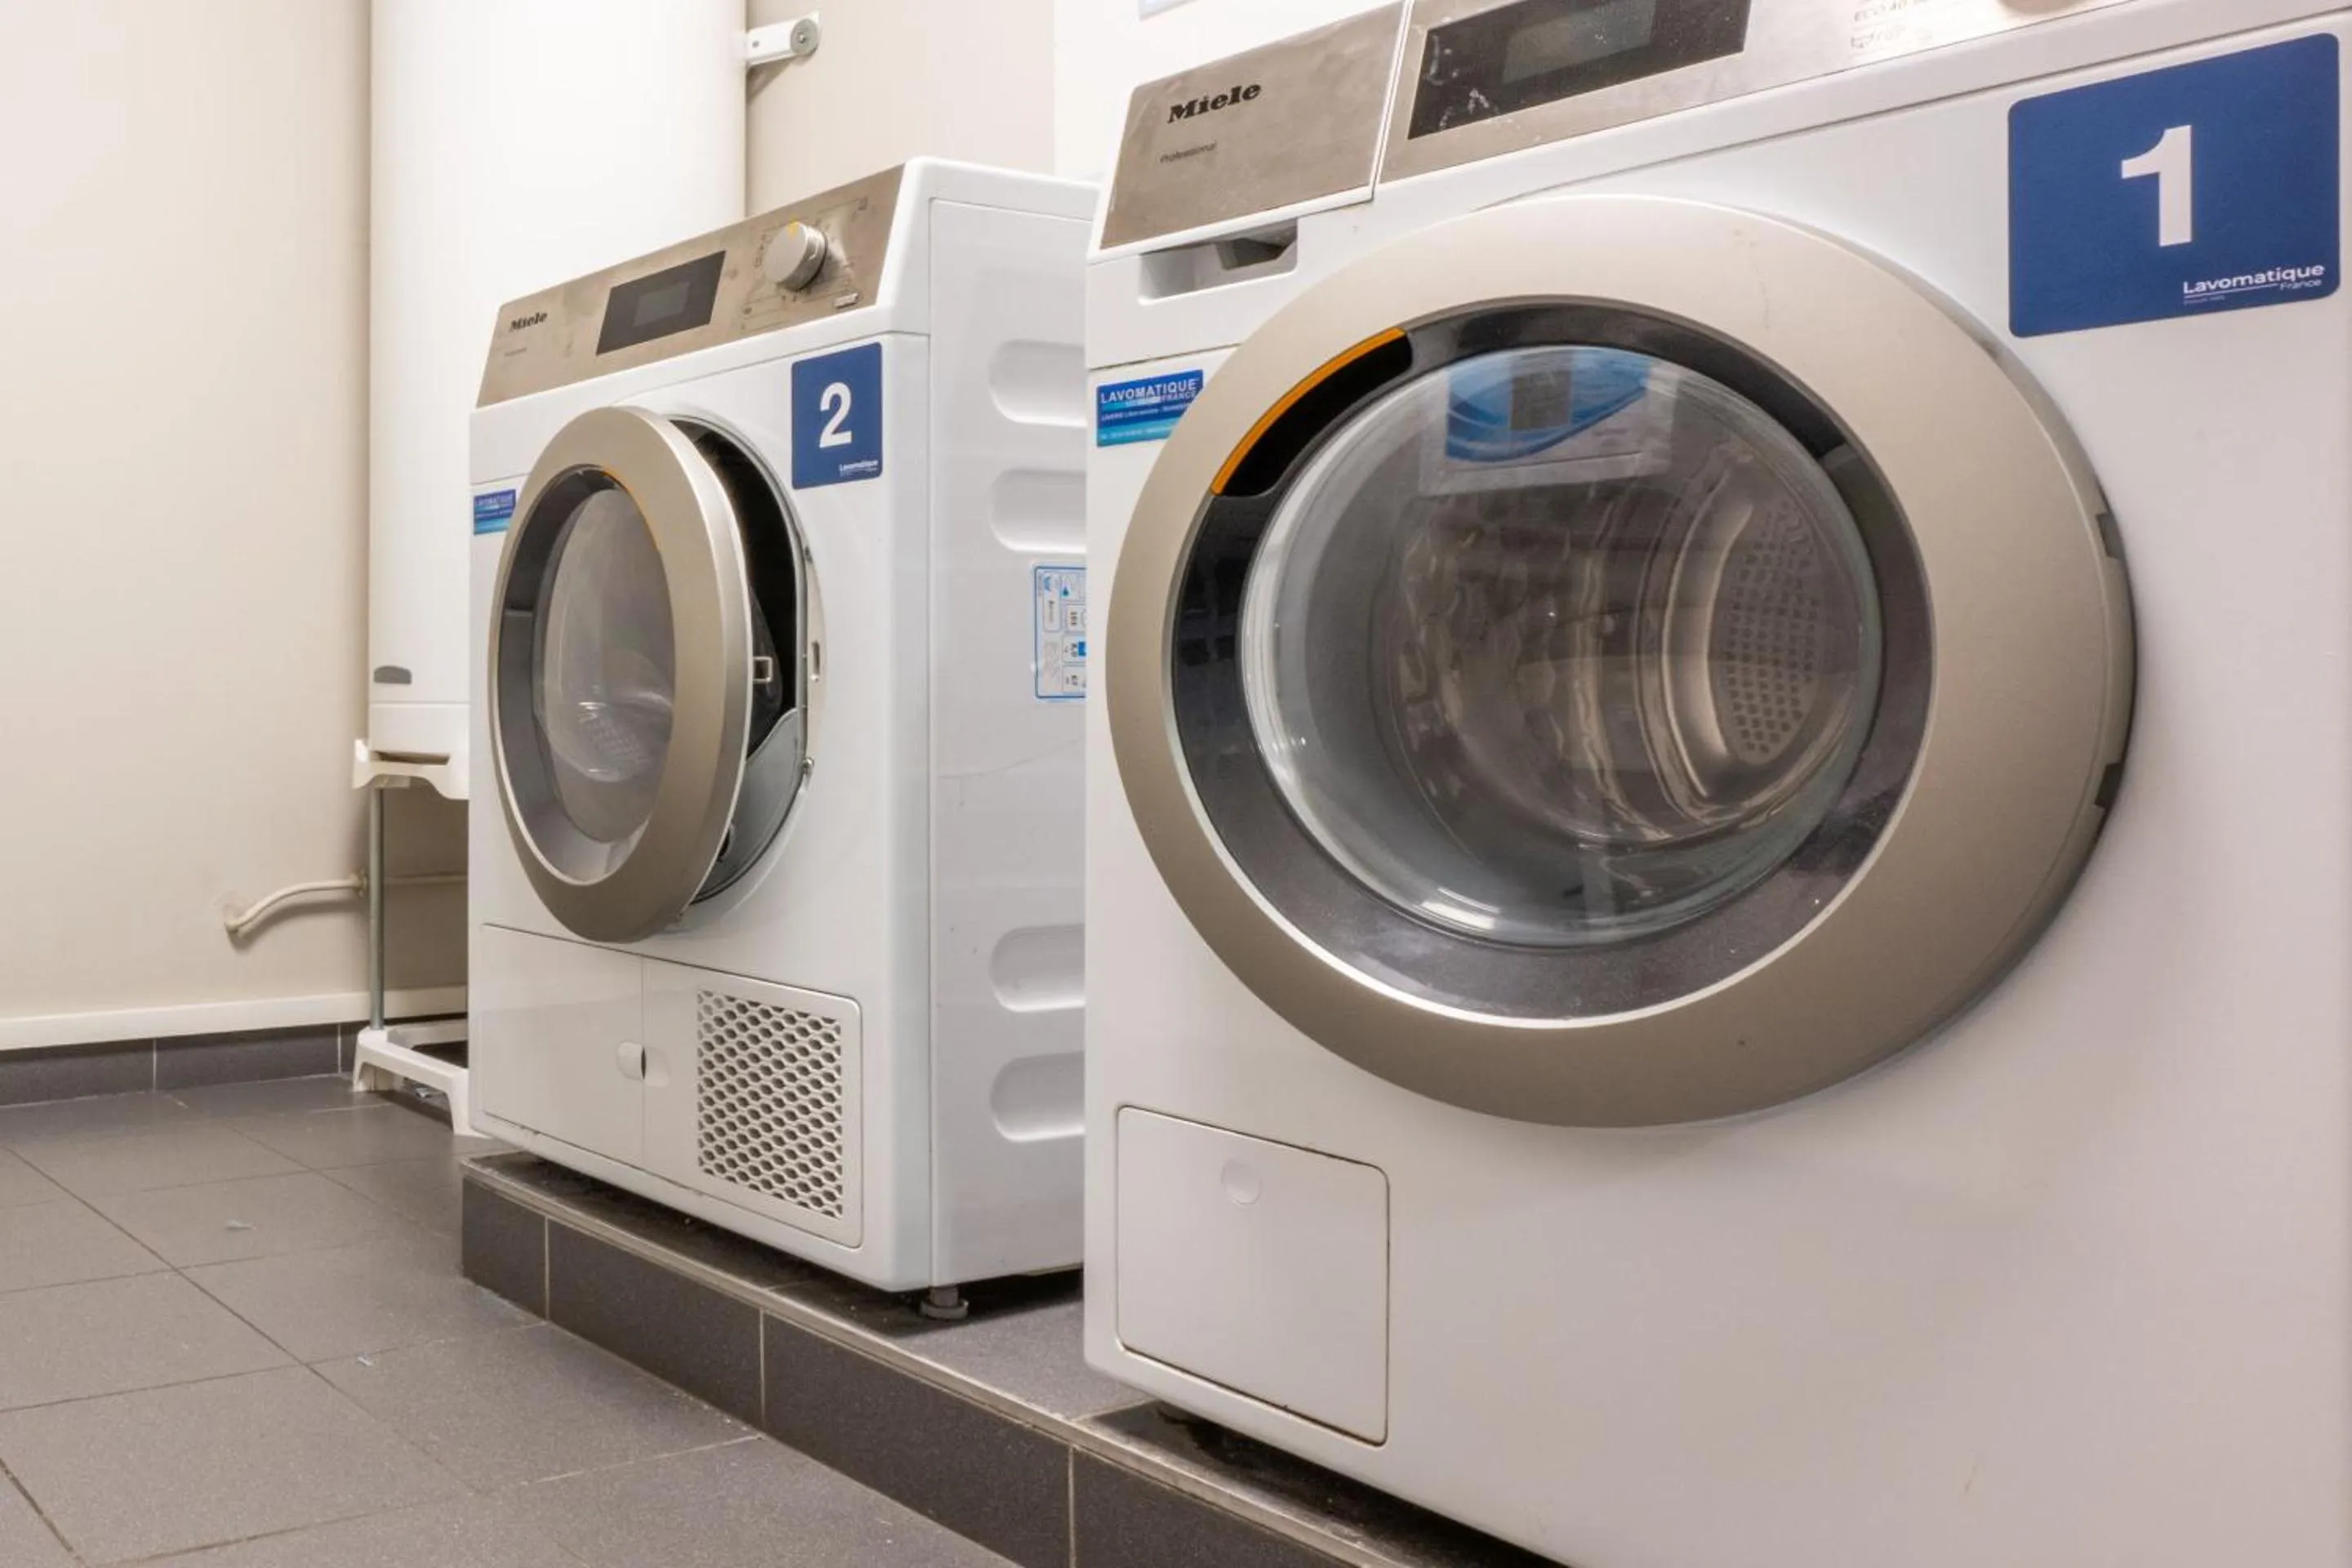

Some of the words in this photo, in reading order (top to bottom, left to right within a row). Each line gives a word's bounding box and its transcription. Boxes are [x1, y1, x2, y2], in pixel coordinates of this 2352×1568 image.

[1167, 83, 1261, 124] Miele
[2121, 125, 2192, 247] 1
[2183, 264, 2325, 294] Lavomatique
[2280, 279, 2322, 291] France
[509, 312, 547, 332] Miele
[1100, 378, 1197, 403] LAVOMATIQUE
[819, 381, 852, 448] 2
